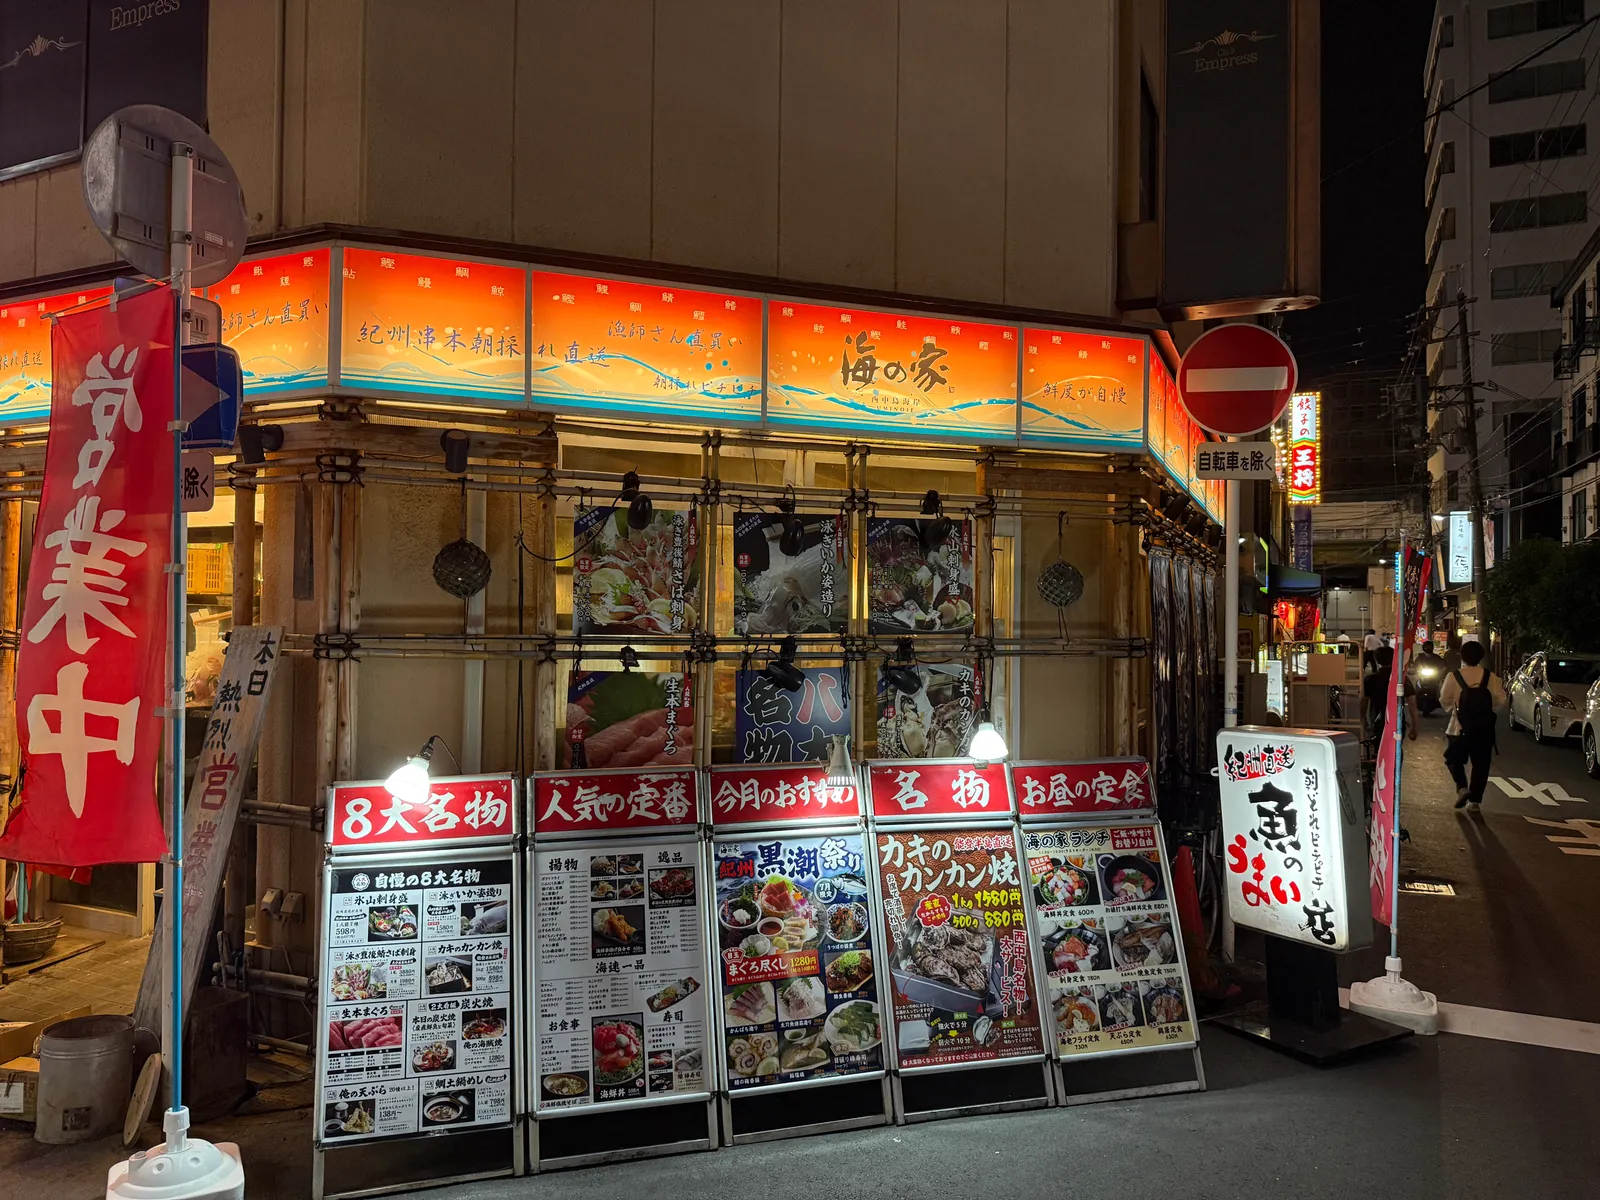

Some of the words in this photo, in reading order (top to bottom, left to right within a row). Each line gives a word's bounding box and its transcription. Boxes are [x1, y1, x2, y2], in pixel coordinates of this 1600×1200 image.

[110, 0, 180, 31] Empress
[1194, 52, 1258, 72] Empress
[381, 258, 395, 269] 鰹
[456, 267, 469, 278] 鯛
[418, 277, 431, 288] 鰻
[491, 286, 504, 296] 鯨
[607, 321, 743, 350] 漁師さん直買い
[841, 331, 949, 393] 海の家
[1042, 382, 1127, 405] 鮮度が自慢
[1297, 398, 1312, 436] 餃子の
[1199, 451, 1272, 472] 自転車を除く
[1294, 449, 1315, 487] 王将
[180, 468, 209, 500] 除く
[820, 520, 834, 617] 泳ぎいか姿造り
[27, 343, 148, 819] 営業中
[253, 632, 275, 696] 本日
[664, 678, 680, 755] 生本まぐろ
[1223, 744, 1296, 783] 紀州直送
[890, 769, 990, 810] 名物
[1021, 769, 1146, 807] お昼の定食
[537, 782, 692, 823] 人気の定番
[341, 791, 508, 840] 8大名物
[1248, 781, 1303, 872] 魚の
[954, 835, 1013, 851] 能登半島直送
[1025, 829, 1110, 850] 海の家ランチ
[1115, 839, 1154, 848] お替り自由
[657, 851, 682, 863] 逸品
[719, 859, 755, 879] 紀州
[757, 841, 821, 879] 黒潮
[820, 838, 861, 872] 祭り
[880, 834, 951, 868] カキの
[549, 858, 578, 871] 揚物
[900, 851, 1020, 892] カンカン焼
[1227, 834, 1302, 907] うまい
[375, 869, 481, 889] 自慢の8大名物
[819, 882, 830, 891] 7月
[354, 893, 409, 905] 氷山刺身盛
[439, 888, 502, 900] 泳ぎいか姿造り
[952, 893, 973, 910] 1kg
[974, 889, 1022, 907] 1580円
[924, 899, 941, 909] 産直
[1043, 908, 1075, 918] 海鮮丼定食
[1105, 903, 1152, 913] お値打ち海鮮丼定食
[953, 915, 979, 928] 500g
[984, 910, 1024, 928] 880円
[438, 944, 502, 954] カキのカンカン焼
[727, 952, 740, 960] 目玉
[728, 957, 788, 974] まぐろ尽くし
[790, 956, 817, 966] 1280円
[1012, 930, 1027, 1015] 西中島名物!
[1137, 968, 1162, 976] 焼魚定食
[1000, 936, 1013, 1017] 大サービス!
[1059, 974, 1085, 983] 刺身定食
[460, 997, 493, 1009] 炭火焼
[342, 1006, 388, 1020] 生本まぐろ
[412, 1014, 456, 1024] 本日の炭火焼
[663, 1010, 684, 1023] 寿司
[548, 1019, 580, 1032] お食事
[1060, 1034, 1100, 1046] 海老フライ定食
[1109, 1030, 1141, 1040] 天ぷら定食
[435, 1076, 483, 1090] 鯛土鍋めし
[339, 1086, 387, 1099] 俺の天ぷら
[599, 1089, 625, 1099] 海鮮丼
